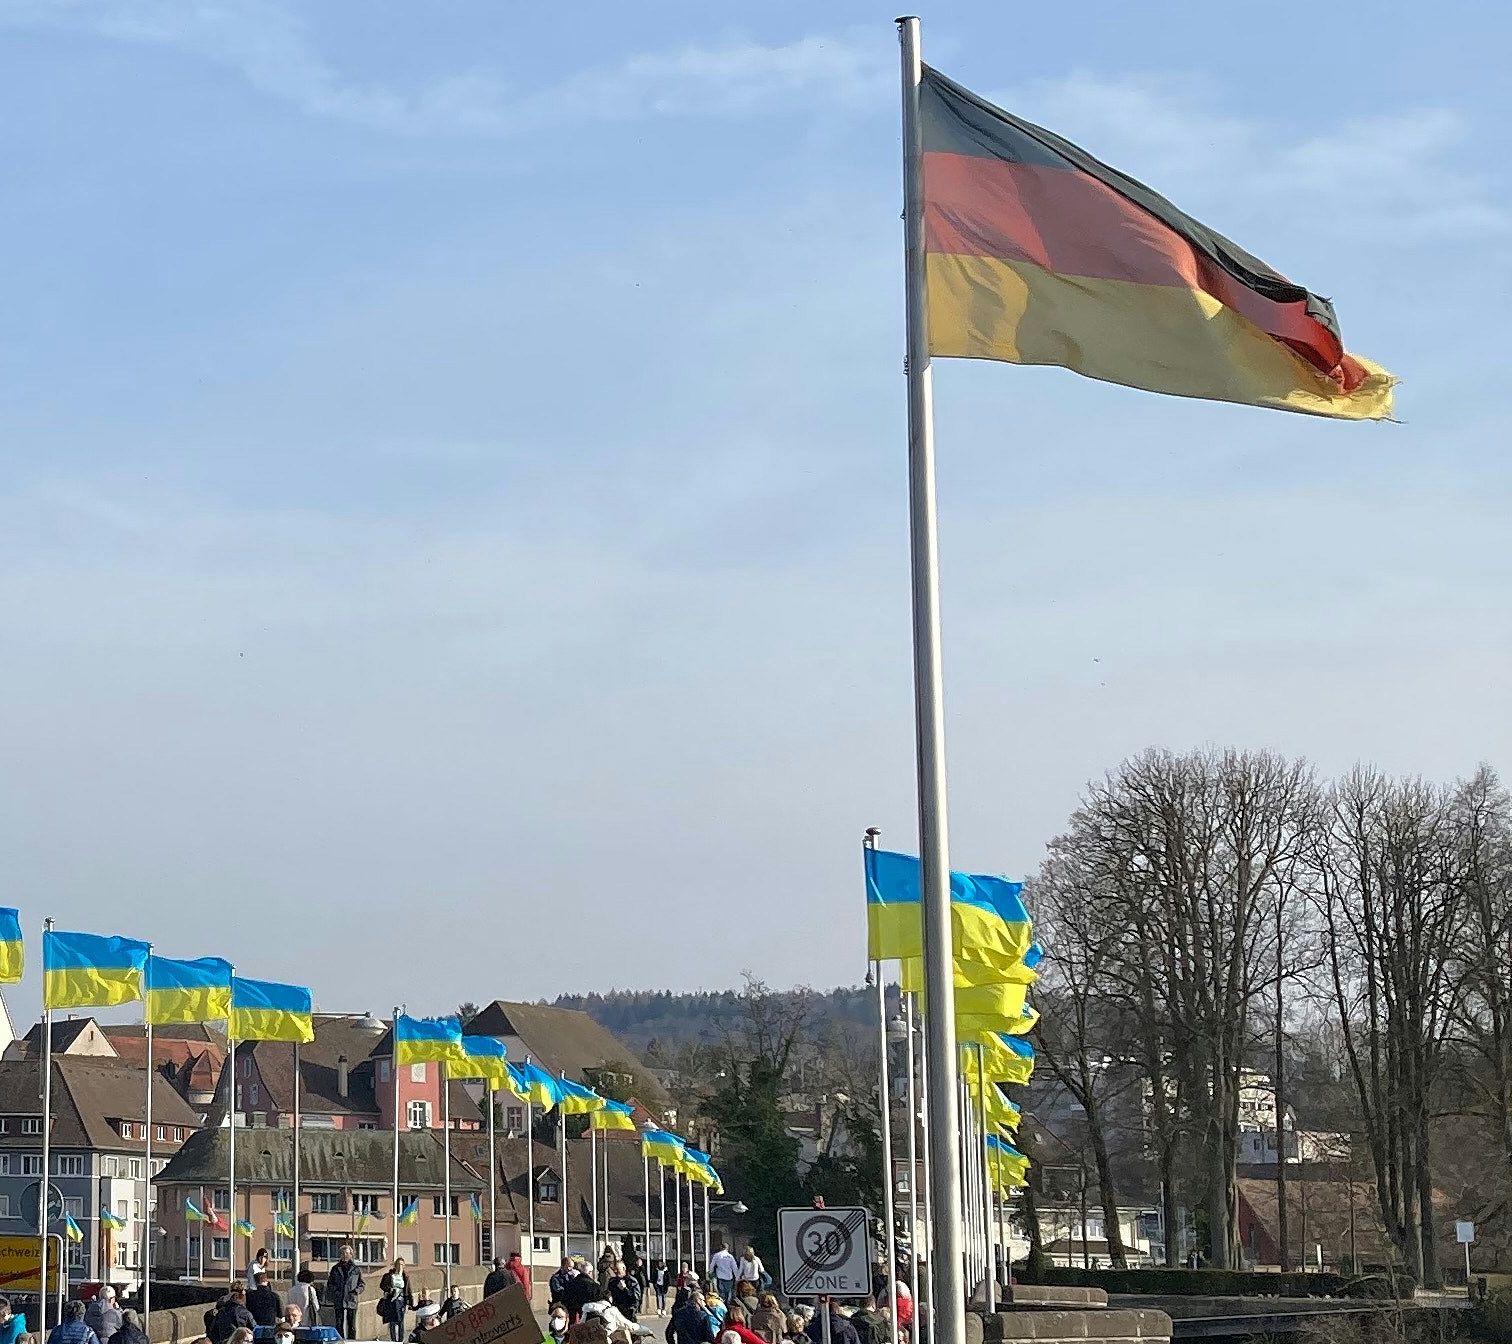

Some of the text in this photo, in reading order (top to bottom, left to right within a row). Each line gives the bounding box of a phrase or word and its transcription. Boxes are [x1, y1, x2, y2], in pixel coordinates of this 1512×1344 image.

[808, 1230, 840, 1256] 30
[805, 1276, 848, 1289] ZONE
[446, 1303, 496, 1341] SO BAD
